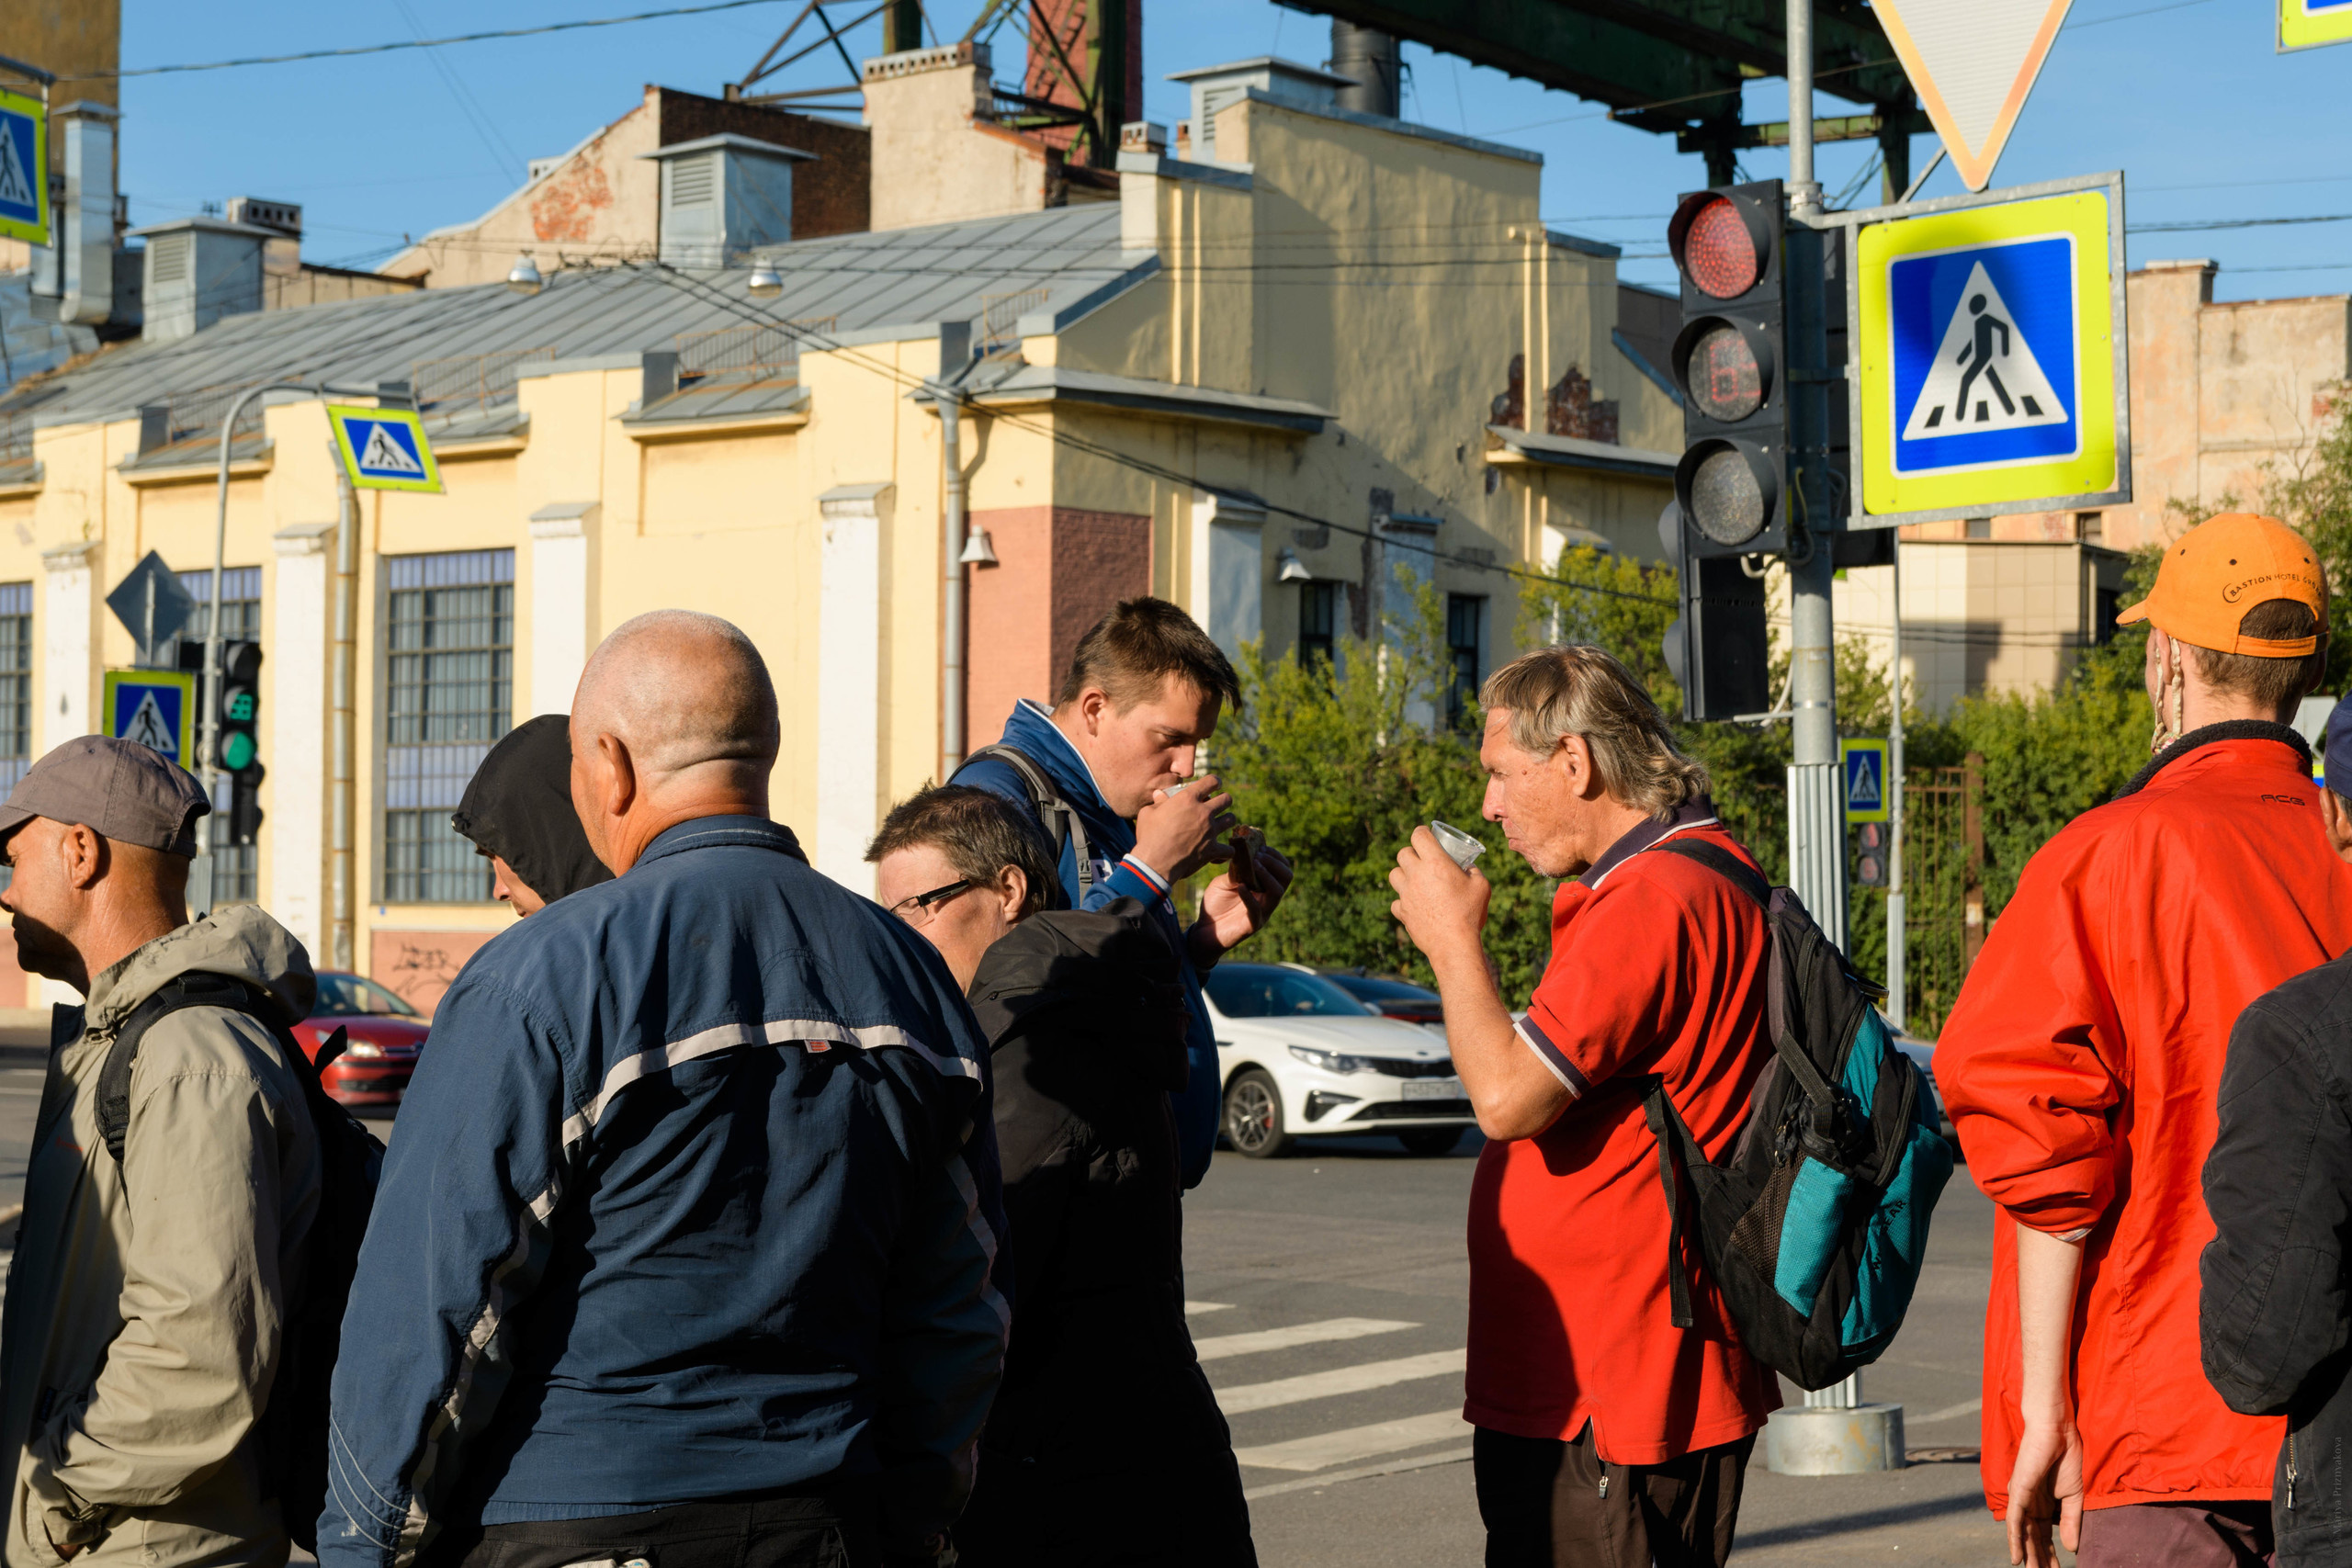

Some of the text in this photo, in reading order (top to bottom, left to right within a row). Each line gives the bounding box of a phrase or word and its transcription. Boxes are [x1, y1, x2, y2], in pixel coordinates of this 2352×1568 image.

[2230, 575, 2272, 597] BASTION
[2275, 573, 2300, 581] HOTEL
[2260, 794, 2305, 806] ACG
